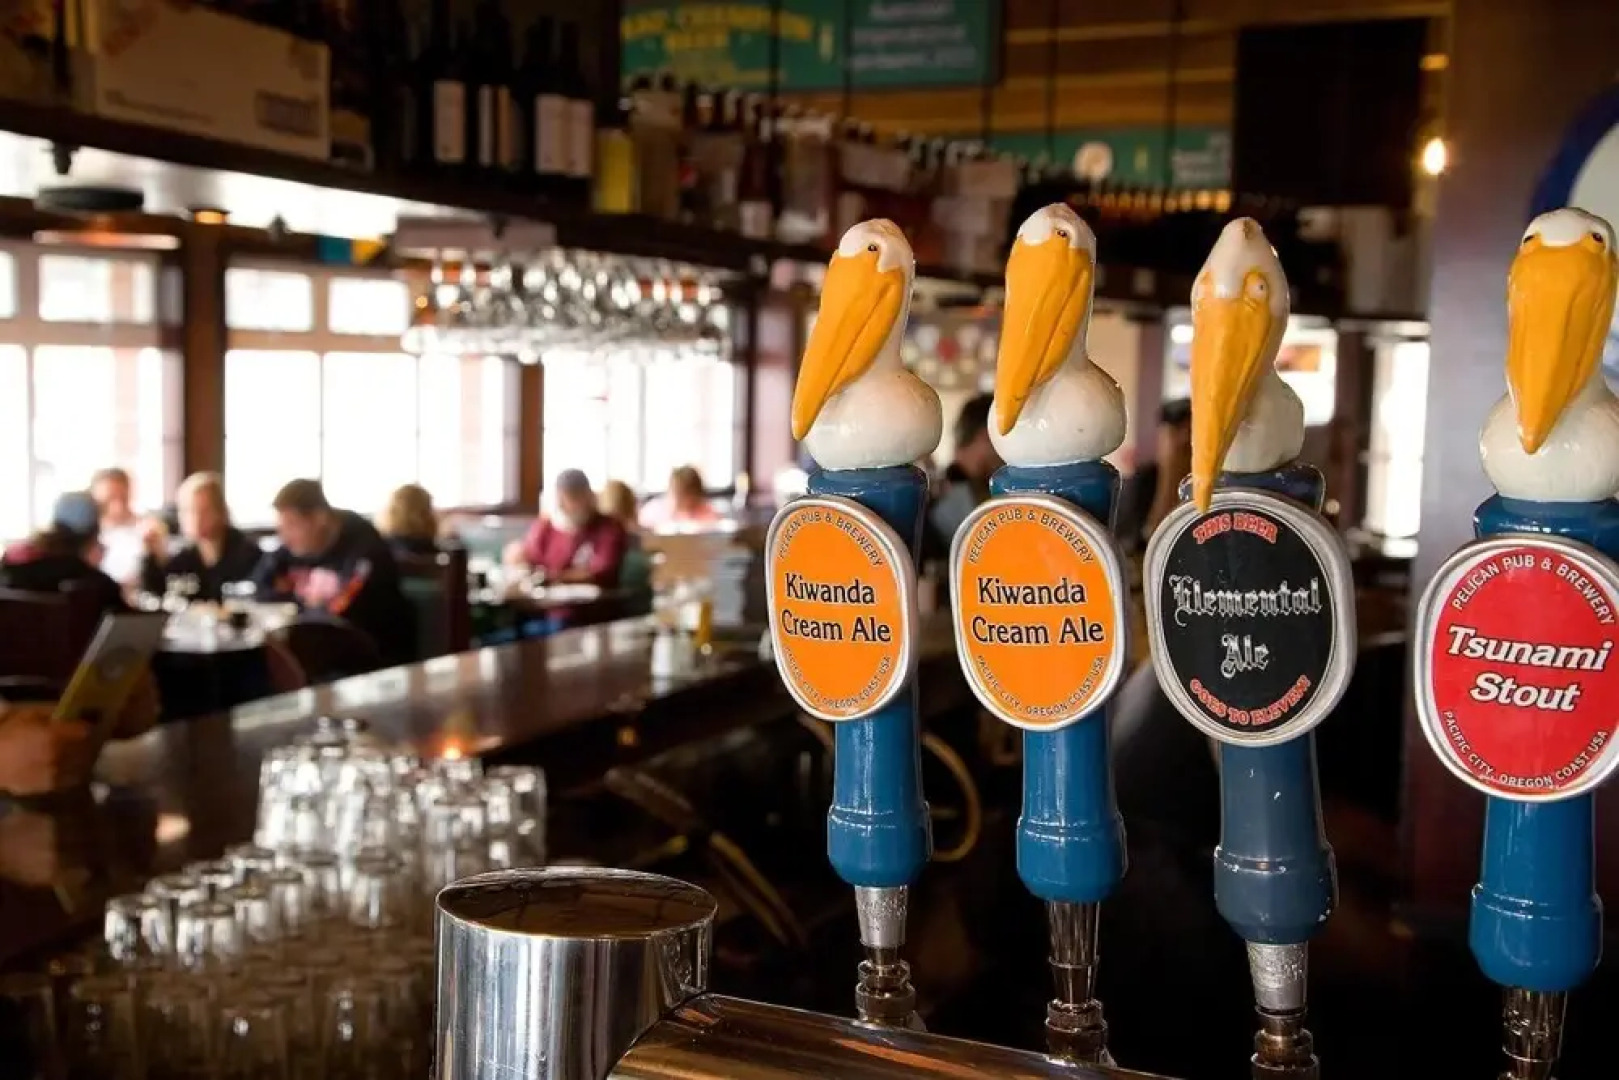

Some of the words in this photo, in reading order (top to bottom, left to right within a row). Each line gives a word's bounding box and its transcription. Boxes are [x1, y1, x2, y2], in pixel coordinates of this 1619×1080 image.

[801, 511, 822, 523] PUB
[825, 512, 833, 523] &
[836, 516, 884, 567] BREWERY
[969, 518, 998, 564] PELICAN
[998, 508, 1023, 524] PUB
[1027, 509, 1036, 521] &
[1040, 513, 1094, 564] BREWERY
[1193, 513, 1231, 544] THIS
[1233, 512, 1278, 544] BEER
[785, 572, 875, 605] Kiwanda
[977, 577, 1087, 606] Kiwanda
[1169, 574, 1322, 627] Elemental
[1451, 562, 1500, 610] PELICAN
[1502, 554, 1535, 570] PUB
[1540, 557, 1553, 571] &
[1556, 563, 1615, 625] BREWERY
[781, 609, 843, 641] Cream
[851, 616, 892, 642] Ale
[972, 616, 1050, 645] Cream
[1058, 617, 1105, 645] Ale
[1447, 623, 1614, 671] Tsunami
[878, 656, 892, 675] USA
[1220, 634, 1270, 679] Ale
[1026, 703, 1069, 717] OREGON
[1068, 677, 1094, 706] COAST
[1092, 656, 1105, 677] USA
[1190, 679, 1228, 718] GOES
[1228, 707, 1250, 725] TO
[1469, 672, 1581, 712] Stout
[1443, 711, 1471, 754] PACIFIC
[1500, 774, 1553, 788] OREGON
[1555, 750, 1590, 780] COAST
[1587, 730, 1608, 752] USA
